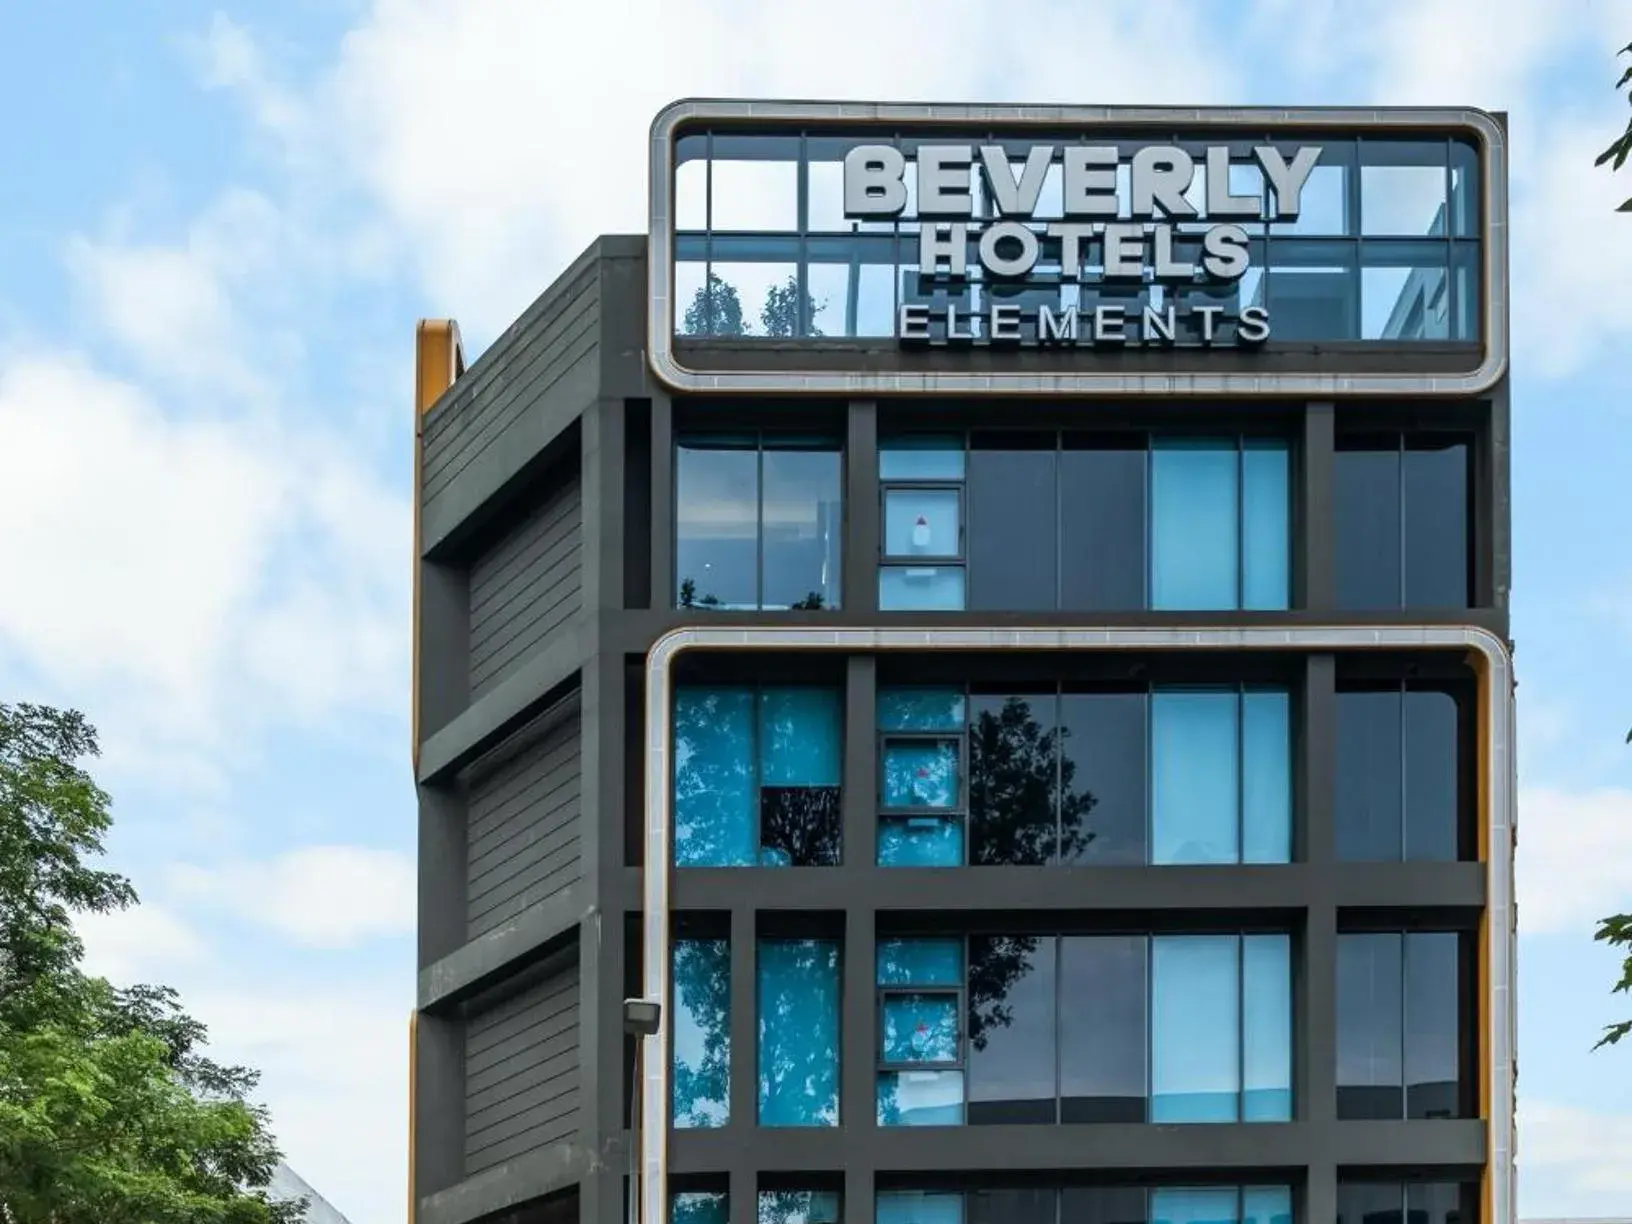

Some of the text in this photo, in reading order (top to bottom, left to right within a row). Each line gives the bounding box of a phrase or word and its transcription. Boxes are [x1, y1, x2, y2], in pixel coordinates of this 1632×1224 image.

[843, 144, 1324, 217] BEVERLY
[919, 221, 1250, 279] HOTELS
[900, 304, 1271, 342] ELEMENTS
